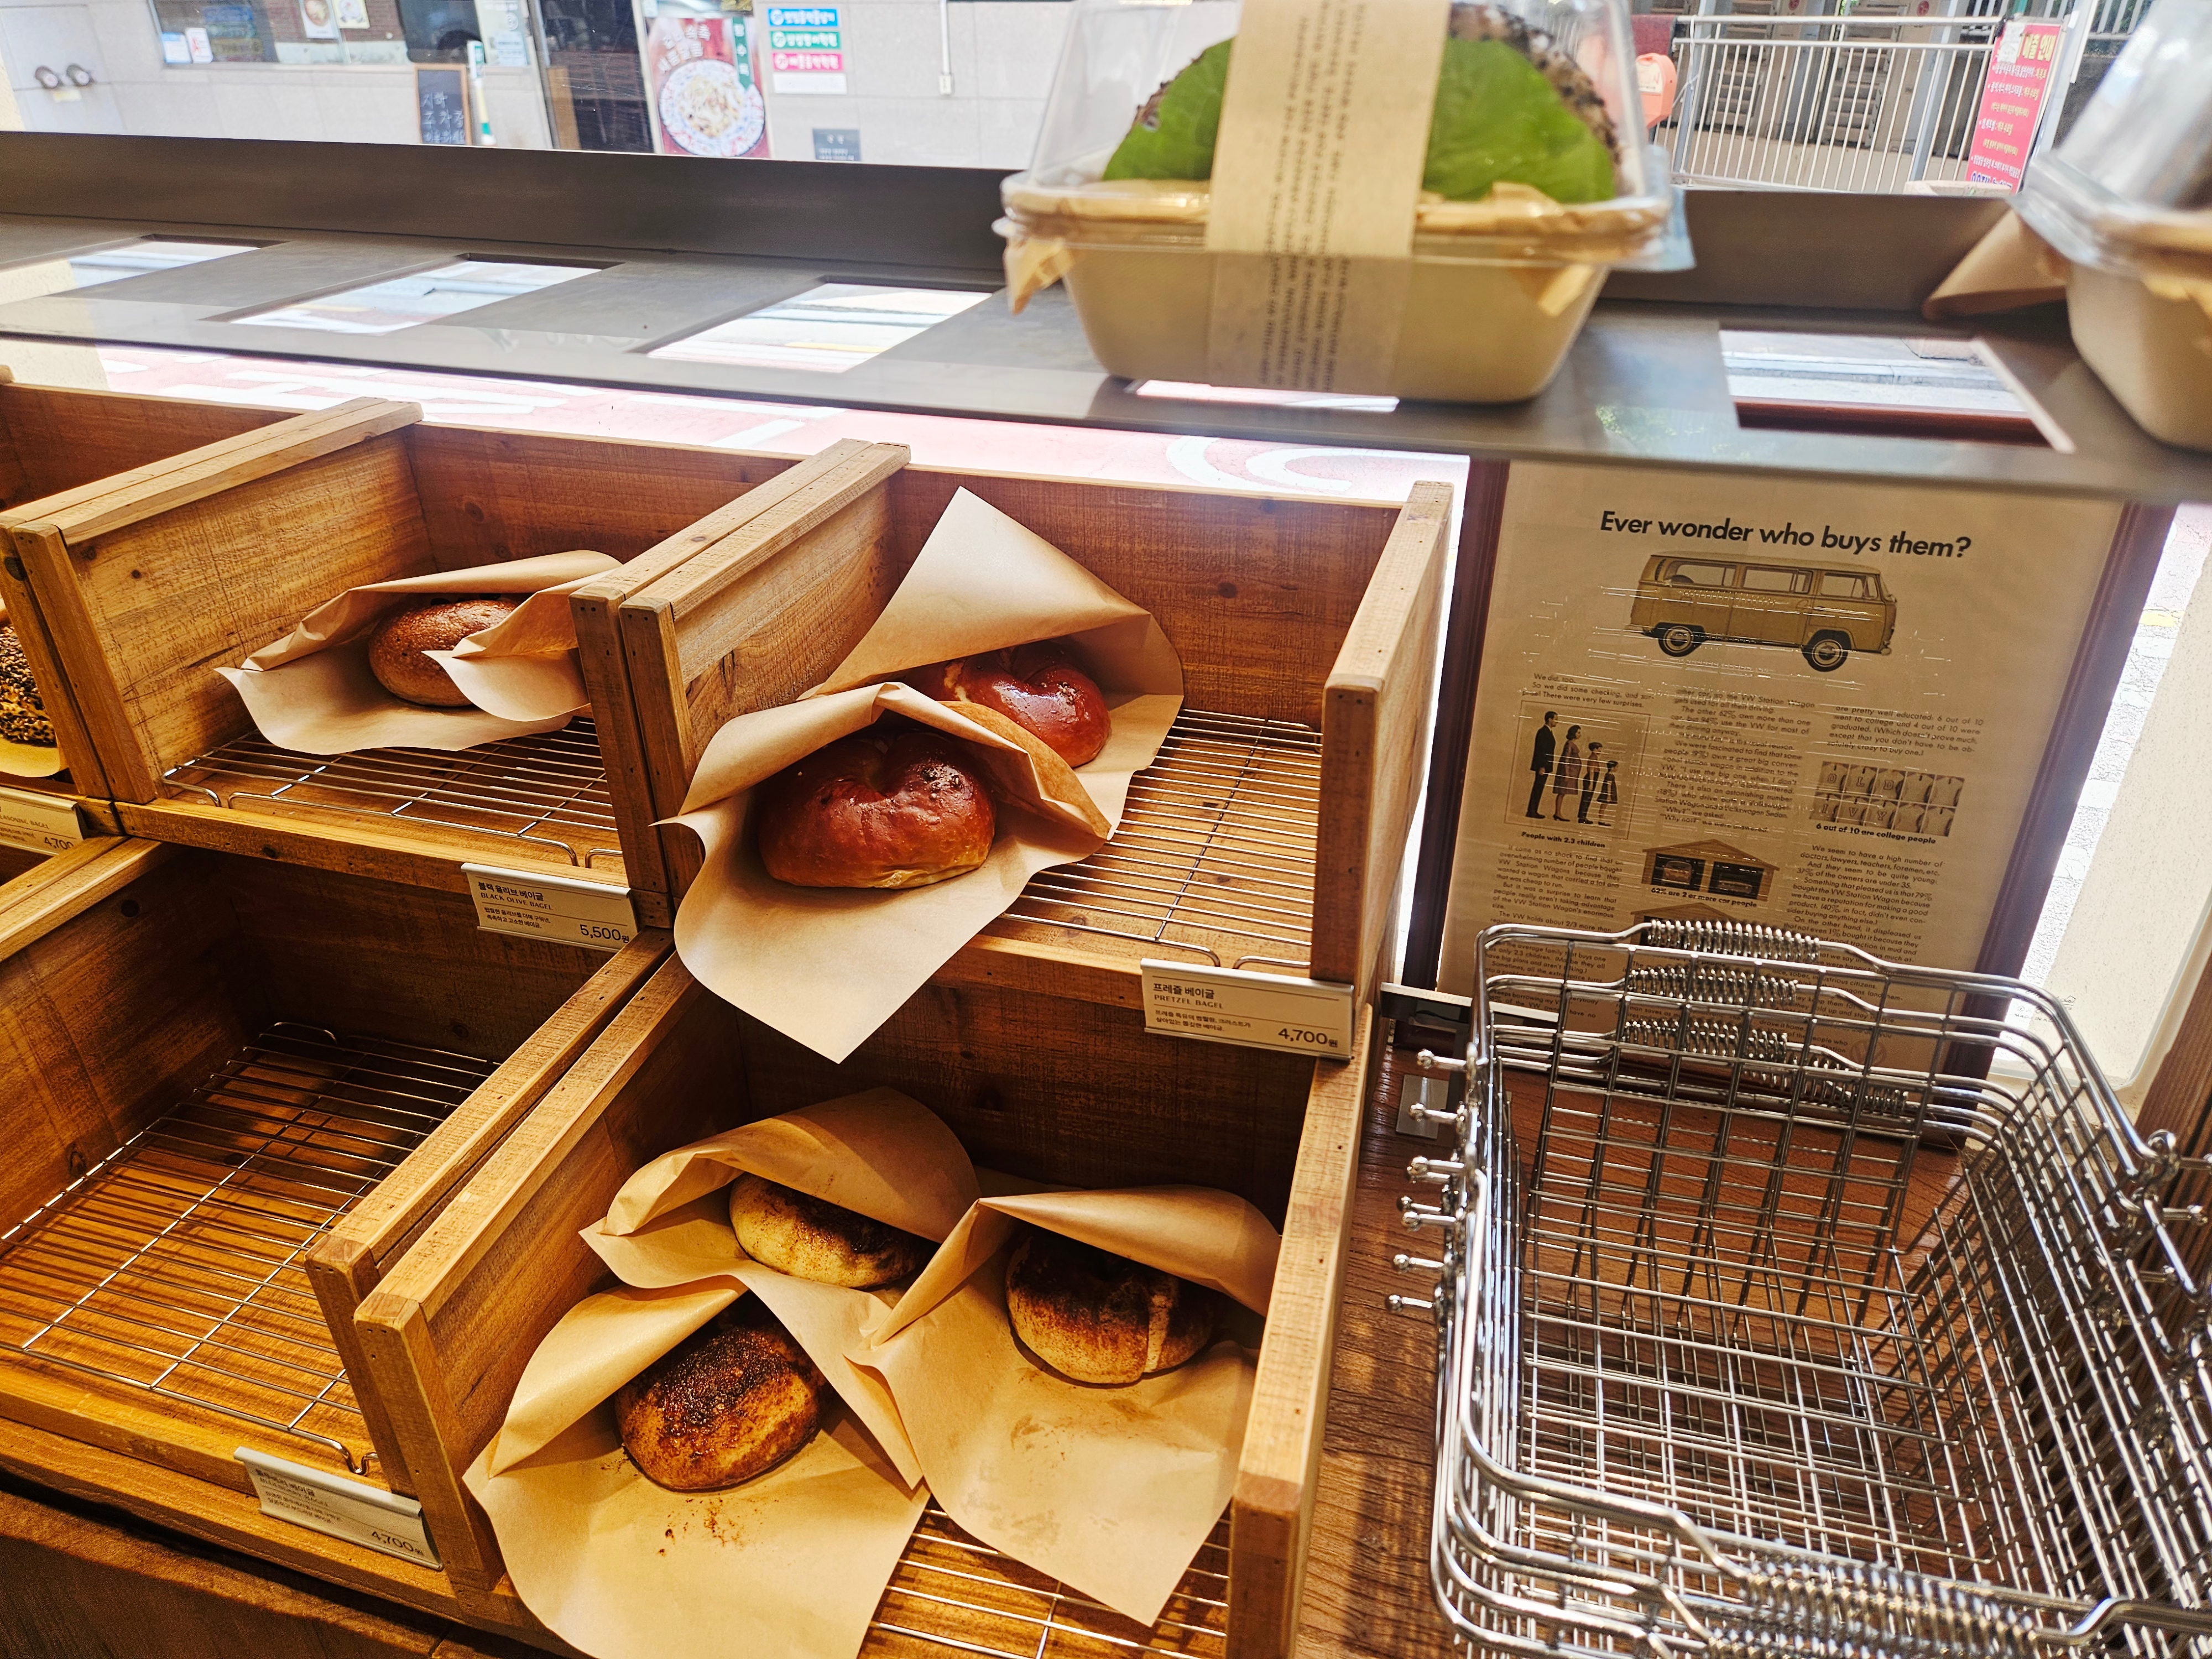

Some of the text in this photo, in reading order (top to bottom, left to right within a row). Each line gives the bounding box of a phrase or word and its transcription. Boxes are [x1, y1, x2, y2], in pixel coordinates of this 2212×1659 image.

[2037, 34, 2057, 62] 안내
[1600, 510, 1971, 556] Ever wonder who buys them?
[1830, 724, 1871, 732] graduated.
[1890, 746, 1902, 754] buy
[1725, 790, 1764, 800] astonishing
[1521, 830, 1545, 840] People
[1577, 839, 1605, 848] children
[1876, 831, 1905, 841] college
[1908, 835, 1936, 844] people
[1801, 851, 1829, 862] doctors,
[1829, 855, 1859, 865] lawyers,
[1860, 859, 1892, 870] teachers,
[1893, 863, 1924, 874] foremen,
[1887, 854, 1901, 862] high
[478, 881, 544, 901] 블랙 올리브 베이글
[1804, 877, 1839, 889] Something
[1856, 885, 1884, 894] pleased
[1584, 893, 1600, 901] learn
[1793, 883, 1817, 893] bought
[1846, 890, 1870, 900] Station
[1873, 894, 1899, 904] Wagon
[1901, 898, 1930, 907] because
[507, 897, 528, 905] OLIVE
[530, 901, 553, 910] BAGEL
[1529, 900, 1550, 909] Station
[1553, 903, 1581, 913] Wagon's
[1583, 909, 1614, 918] enormous
[1560, 898, 1578, 906] taking
[1581, 901, 1614, 911] advantage
[1731, 899, 1756, 907] people
[1805, 909, 1827, 919] buying
[1829, 914, 1858, 923] anything
[580, 924, 629, 943] 5,500원
[1154, 983, 1214, 999] 프레즐 베이글
[1154, 994, 1223, 1009] PRETZEL BAGEL
[1278, 1028, 1338, 1047] 4,700원
